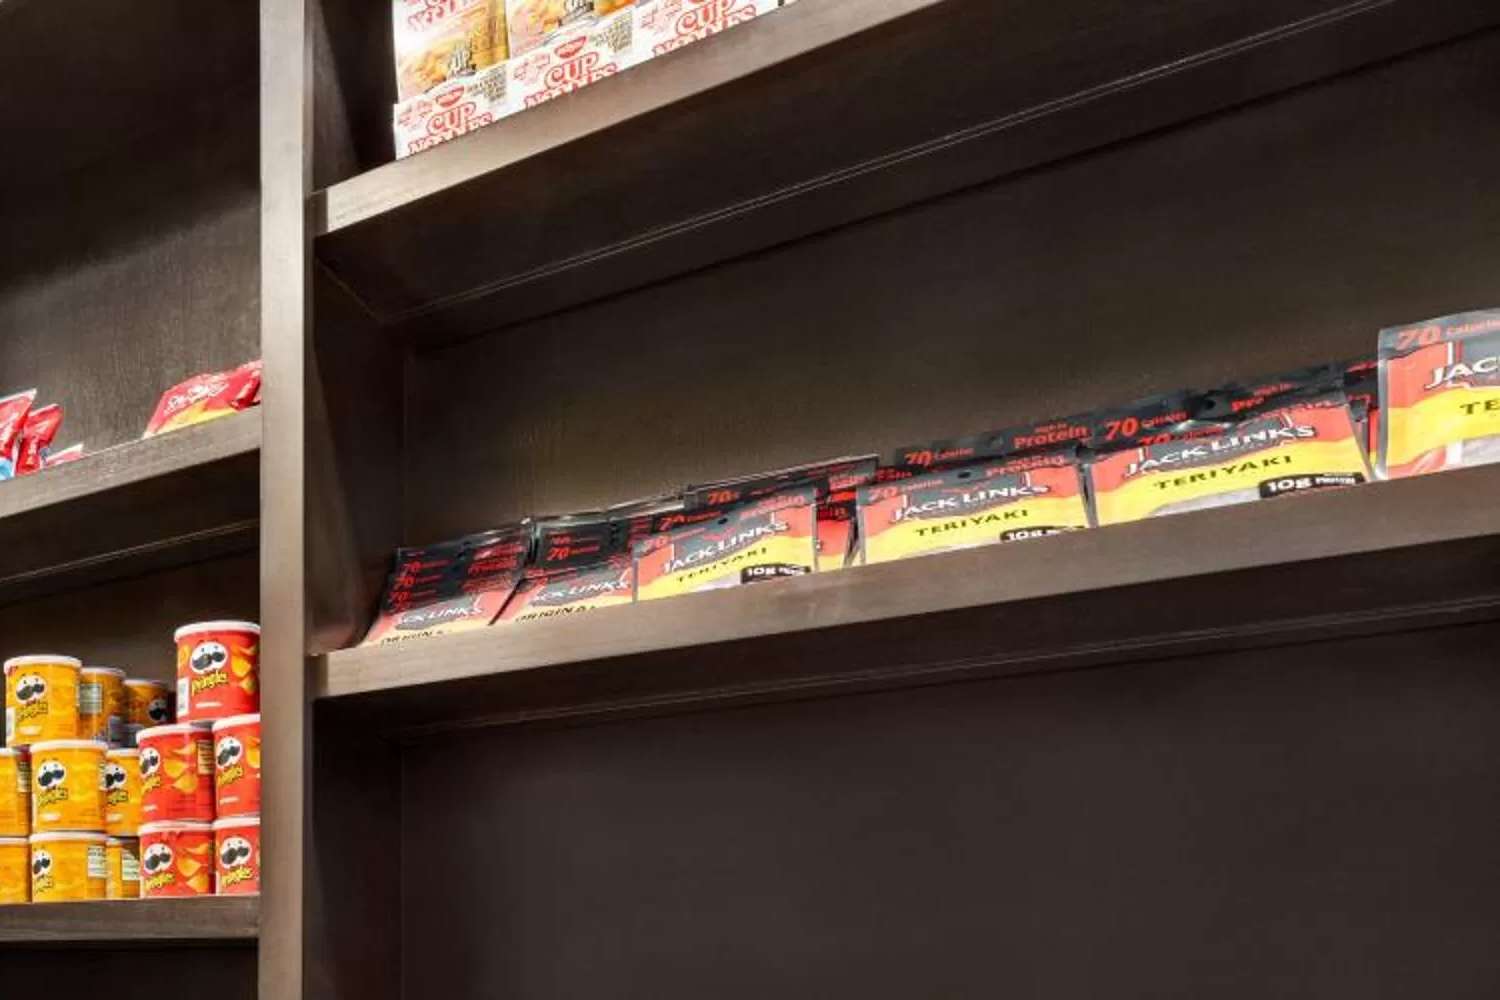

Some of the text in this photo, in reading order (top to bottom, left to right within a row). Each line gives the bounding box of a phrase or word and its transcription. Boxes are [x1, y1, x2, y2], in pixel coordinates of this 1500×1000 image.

[545, 52, 599, 89] CUP
[426, 101, 477, 136] CUP
[1013, 426, 1089, 449] Protein
[1104, 417, 1137, 441] 70
[1123, 445, 1208, 478] JACK
[1152, 454, 1293, 490] TERIYAKI
[893, 493, 957, 523] JACK
[915, 508, 1029, 537] TERIYAKI
[663, 543, 715, 574] JACK
[677, 546, 768, 582] TERIYAKI
[191, 669, 228, 696] Pringles
